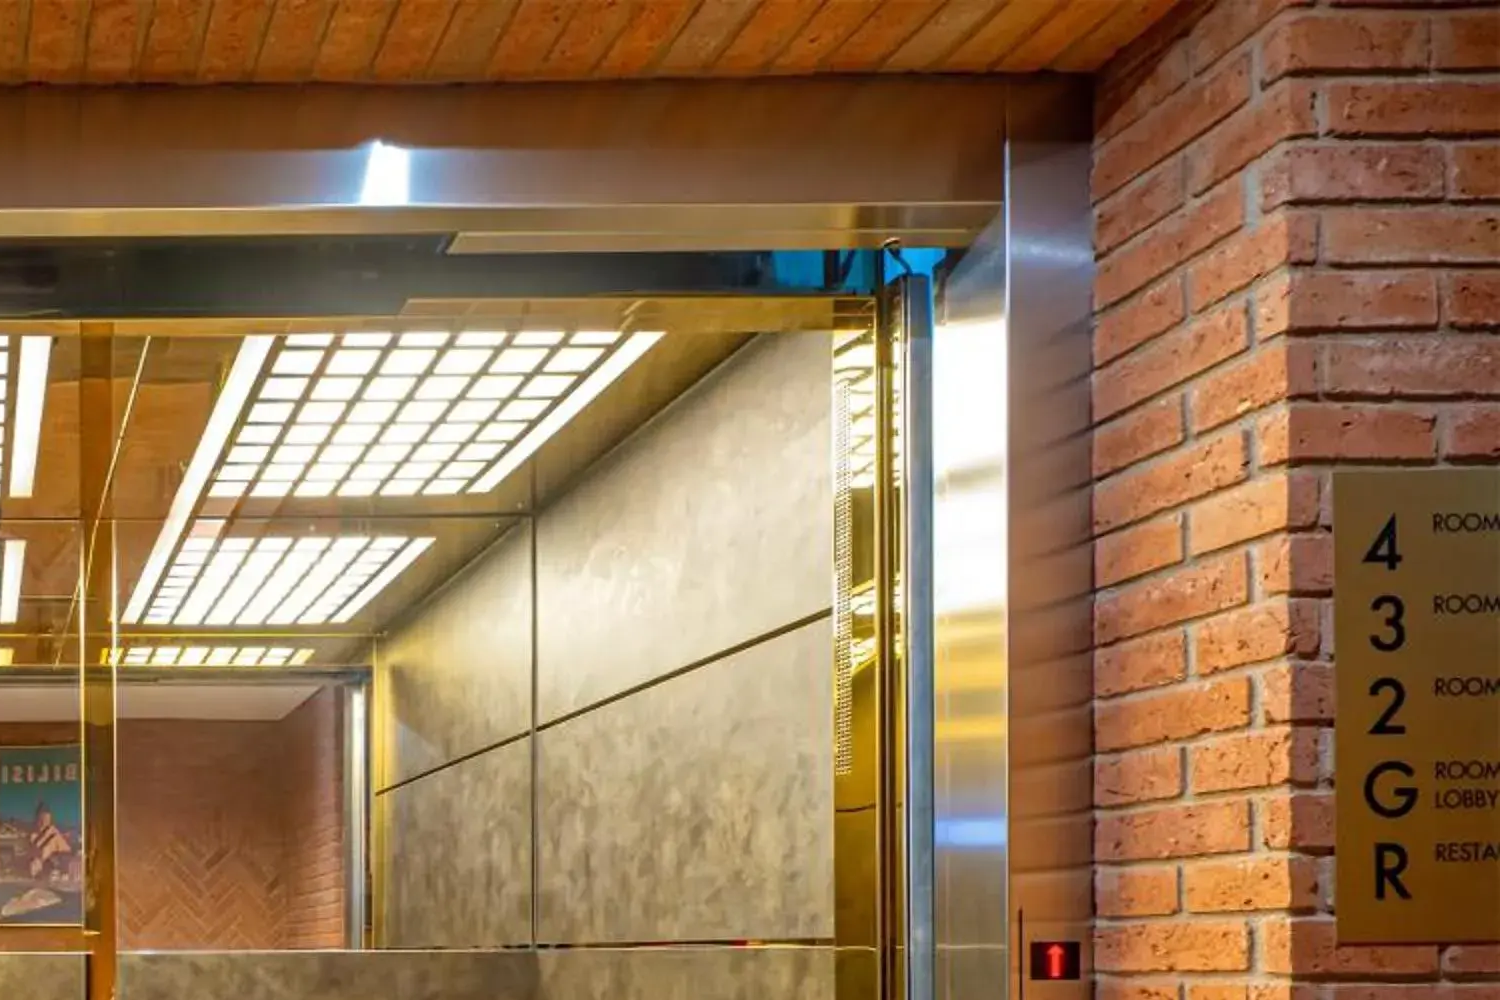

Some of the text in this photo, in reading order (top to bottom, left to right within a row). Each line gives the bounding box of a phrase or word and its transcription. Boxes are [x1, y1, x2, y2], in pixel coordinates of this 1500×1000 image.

[1362, 513, 1402, 570] 4
[1369, 595, 1406, 652] 3
[1368, 677, 1406, 735] 2
[1364, 761, 1418, 818] G
[1435, 789, 1500, 809] LOBBY
[1374, 843, 1412, 900] R
